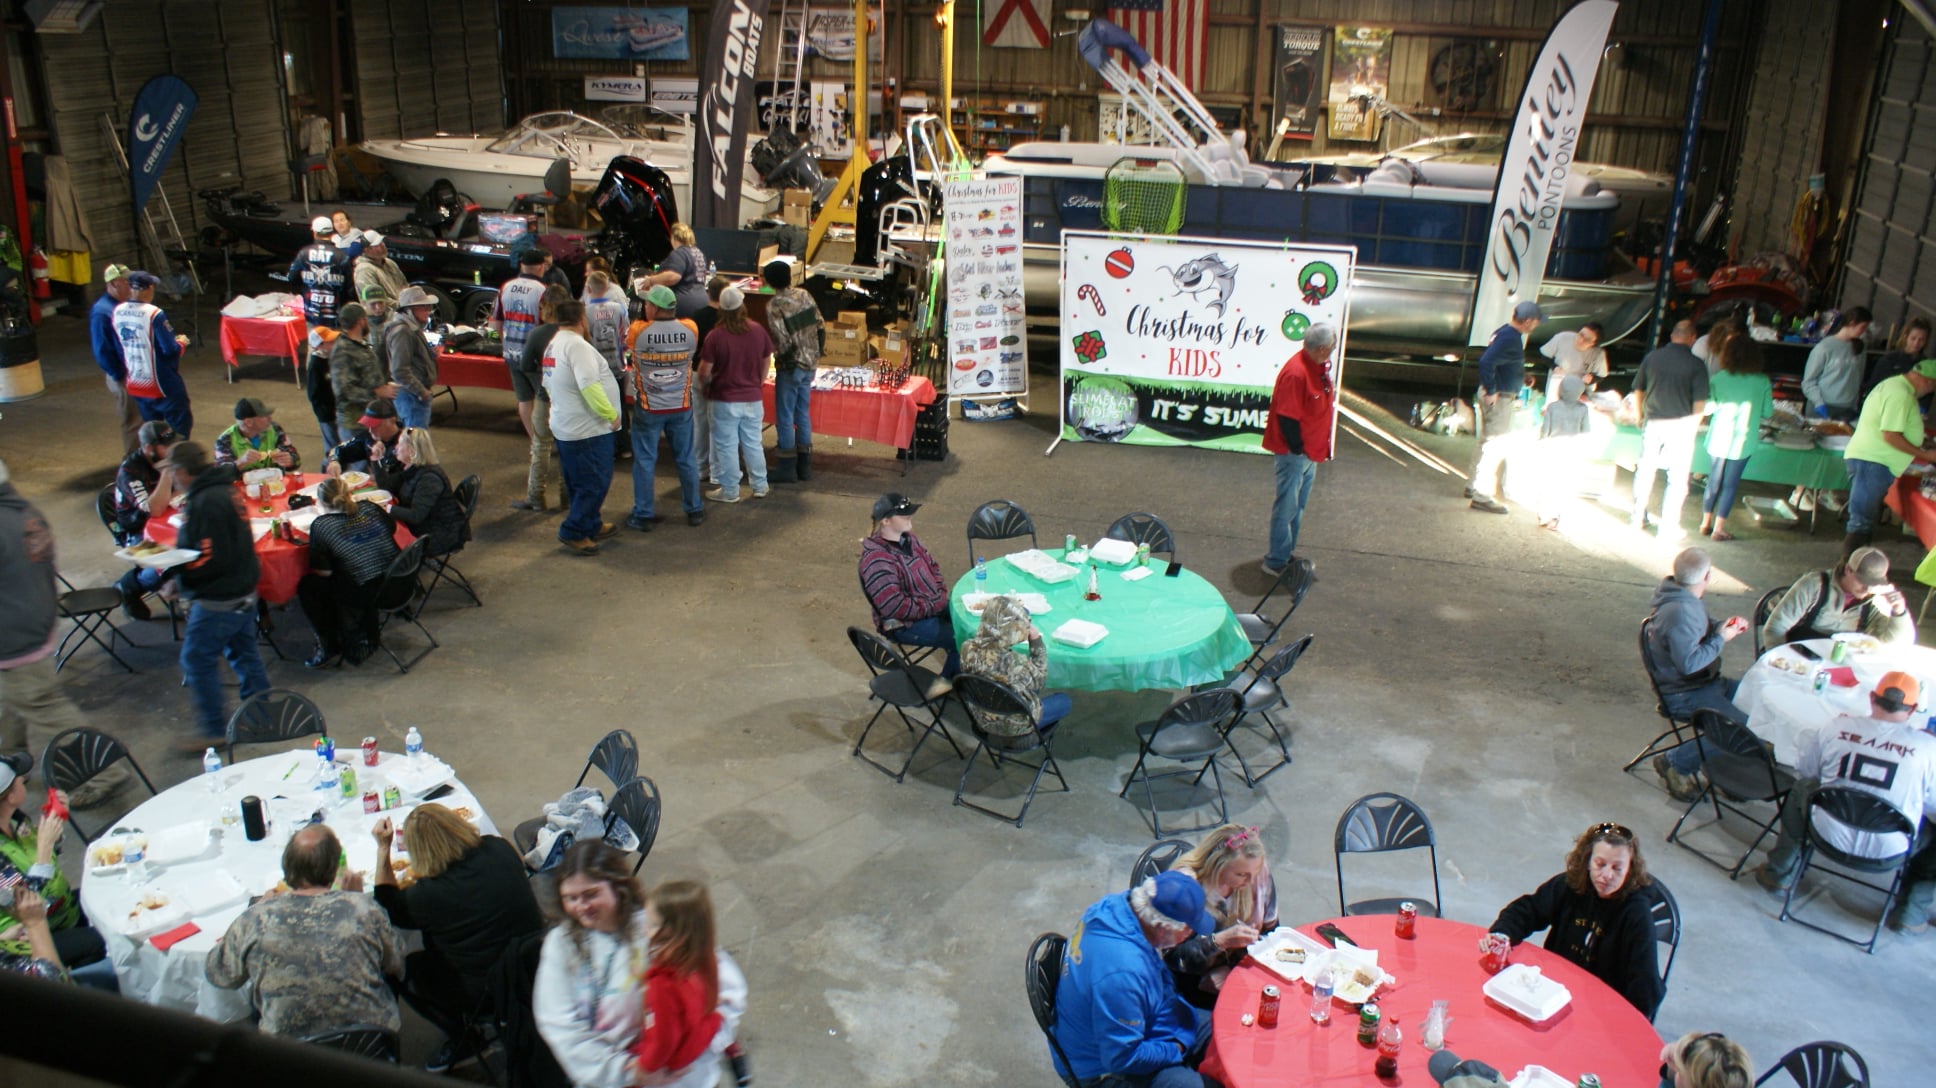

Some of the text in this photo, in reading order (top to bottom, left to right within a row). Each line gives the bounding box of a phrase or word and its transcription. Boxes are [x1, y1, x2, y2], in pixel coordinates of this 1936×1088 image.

[743, 13, 763, 79] BOATS
[1283, 40, 1320, 51] TORQUE
[591, 81, 642, 90] KYMERA
[712, 0, 750, 200] FALCON
[143, 103, 185, 173] CRESTLINER
[947, 182, 1017, 198] Christmas for KIDS
[1538, 126, 1577, 230] PONTOONS
[511, 285, 533, 295] DALY
[647, 332, 687, 344] FULLER
[1126, 303, 1268, 350] Christmas for
[1168, 347, 1222, 379] KIDS
[1152, 399, 1200, 421] IT'S
[1837, 751, 1899, 791] 10
